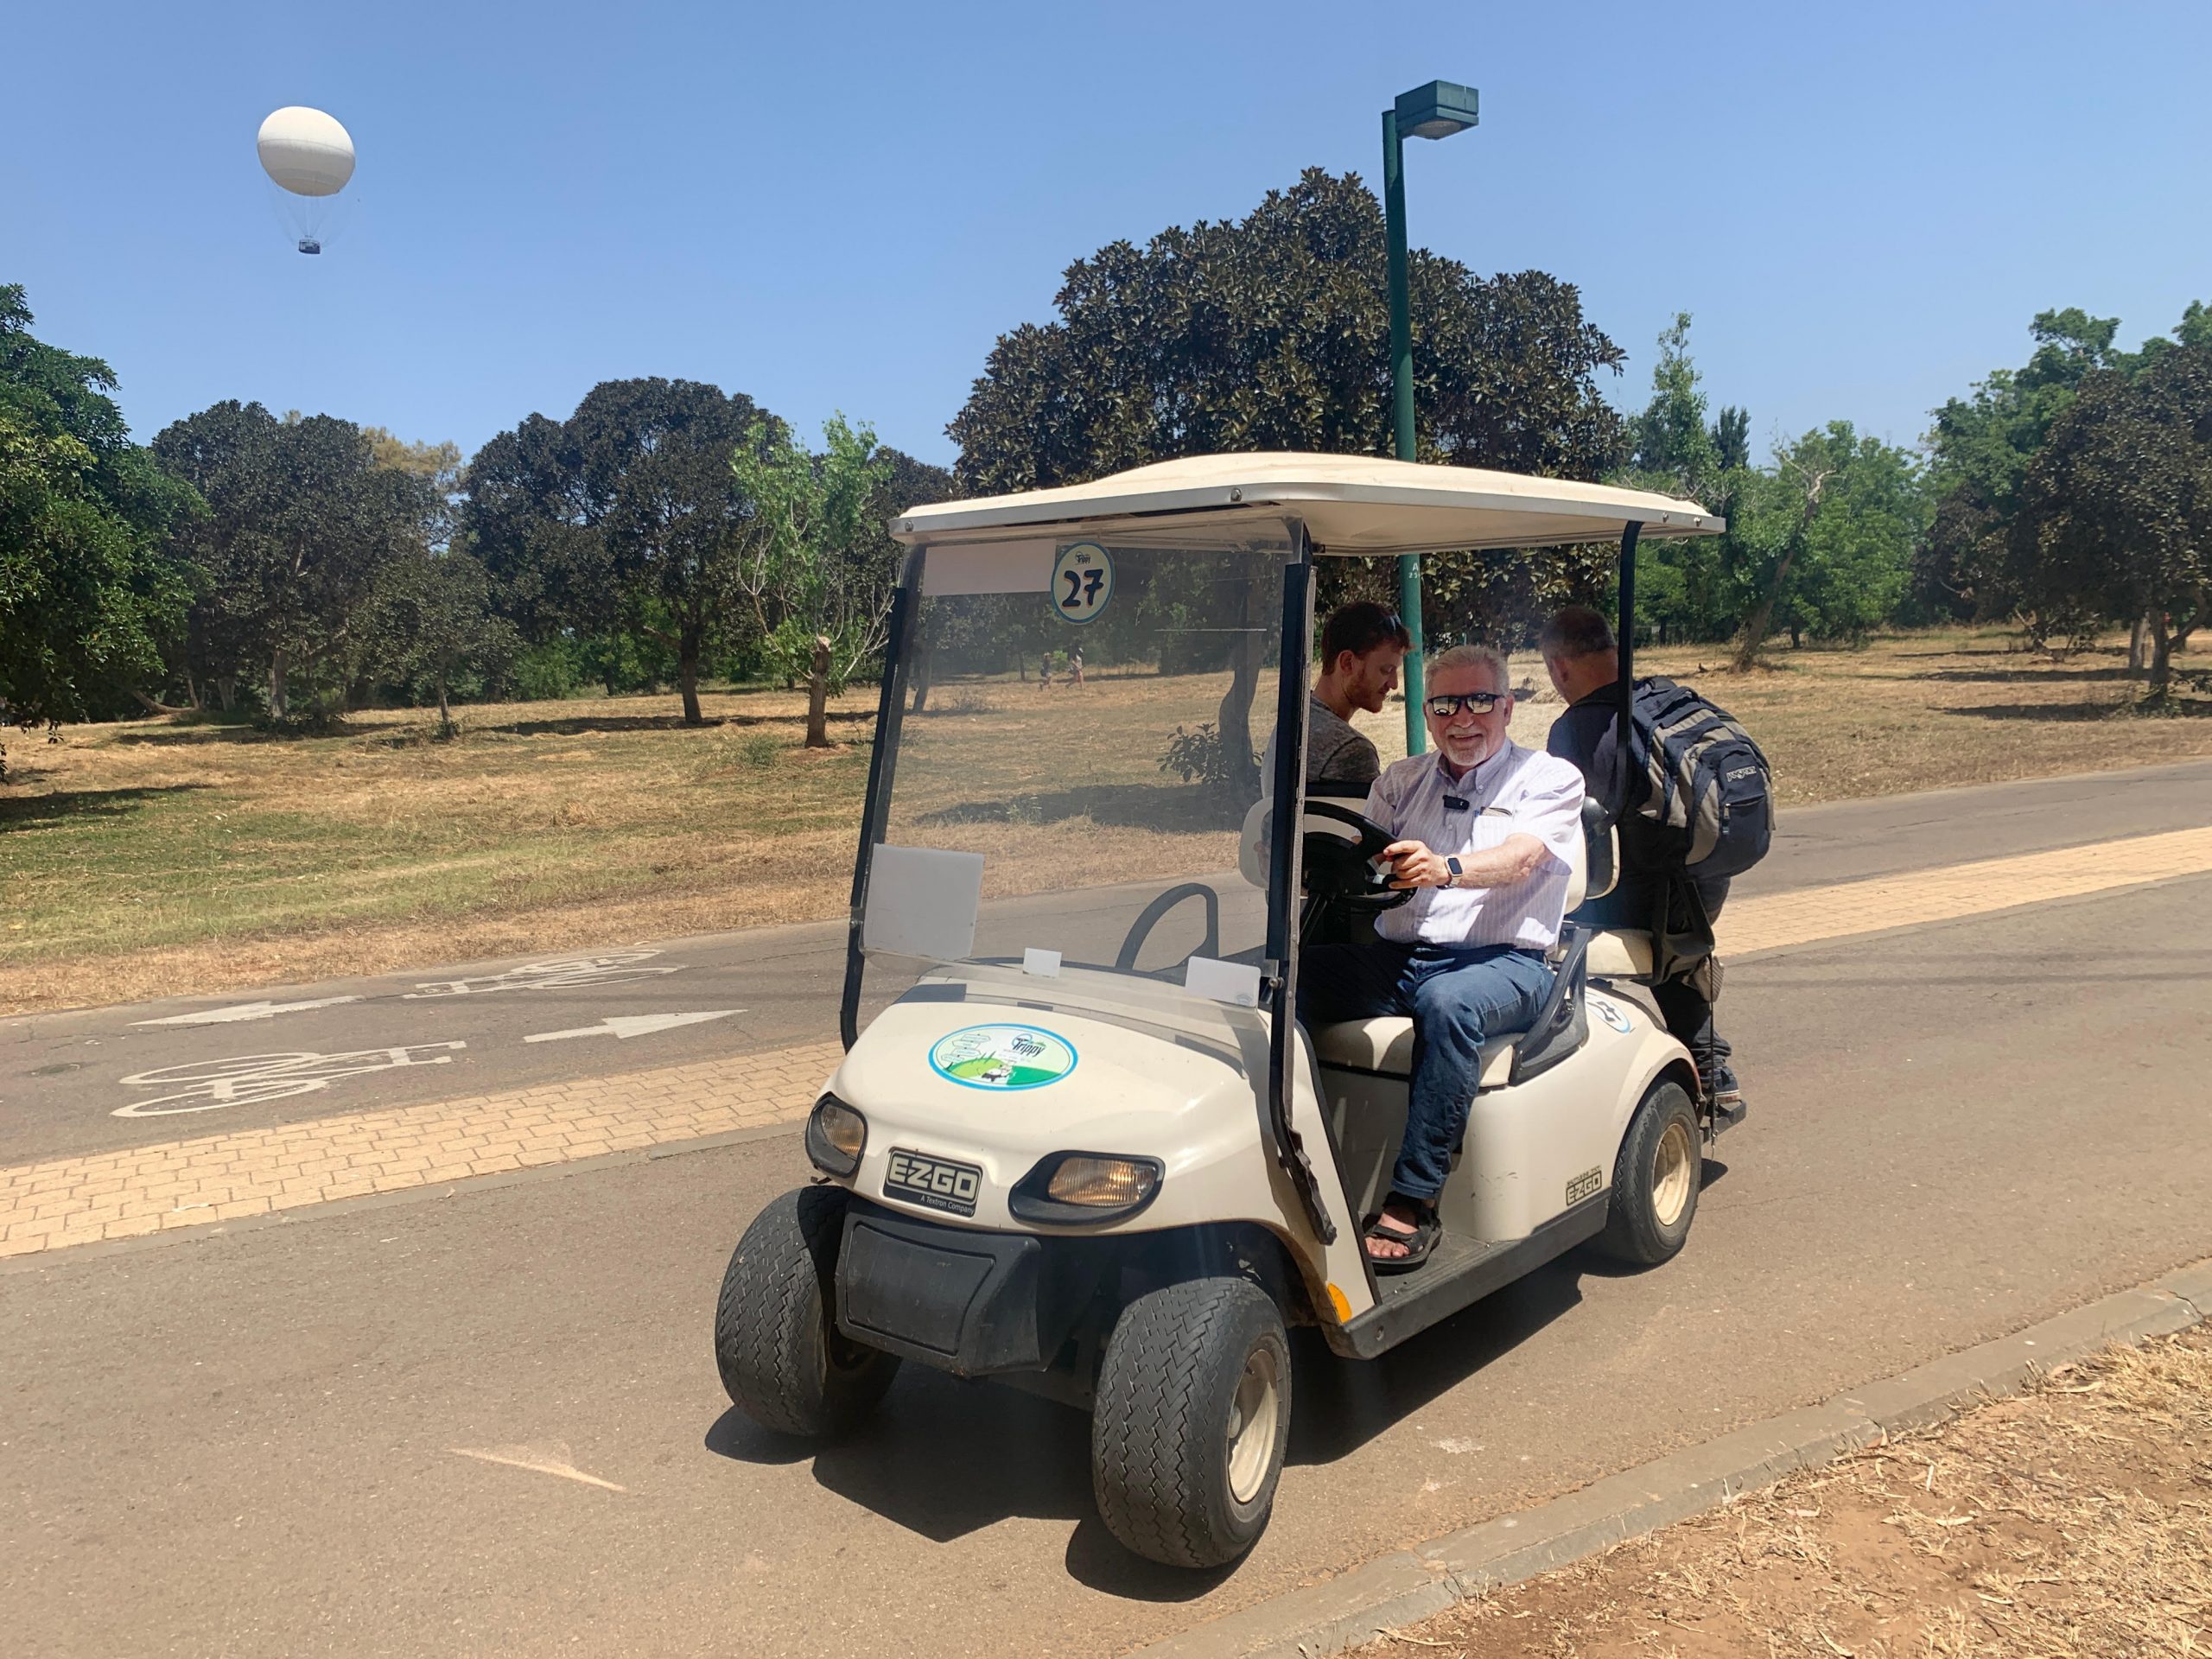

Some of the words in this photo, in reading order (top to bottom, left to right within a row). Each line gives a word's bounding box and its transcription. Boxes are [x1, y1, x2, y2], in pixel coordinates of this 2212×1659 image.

[1413, 563, 1419, 571] A
[1062, 569, 1104, 607] 27
[1013, 1038, 1046, 1058] Trippy
[888, 1156, 979, 1199] EZGO
[1566, 1171, 1601, 1205] EZGO
[927, 1196, 947, 1208] Textron
[947, 1201, 975, 1215] Company
